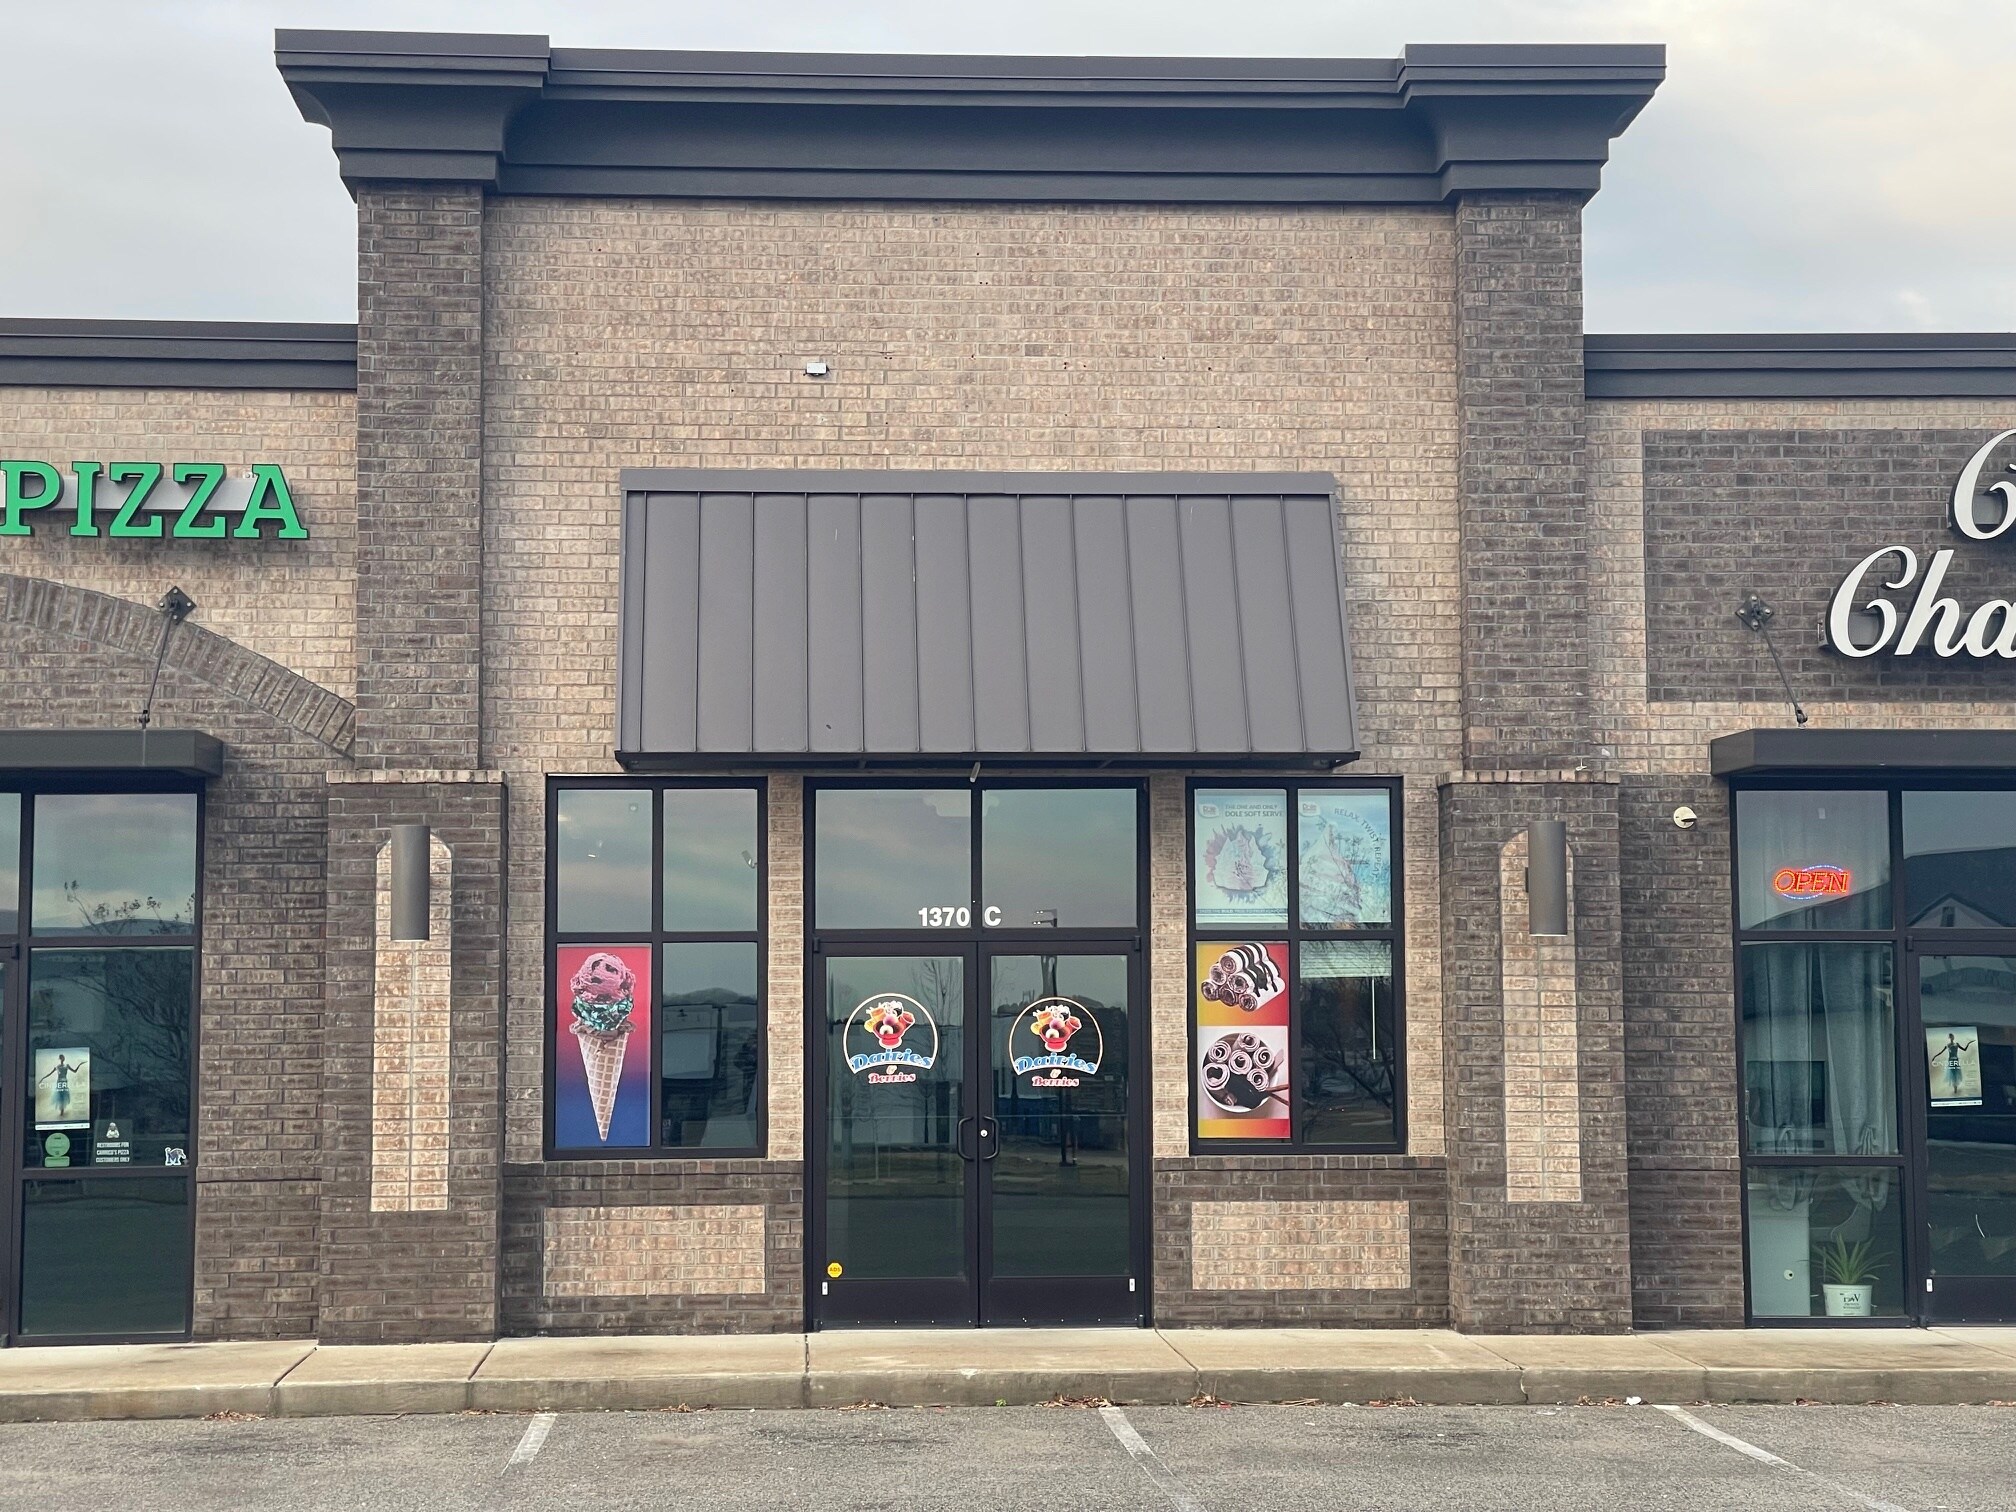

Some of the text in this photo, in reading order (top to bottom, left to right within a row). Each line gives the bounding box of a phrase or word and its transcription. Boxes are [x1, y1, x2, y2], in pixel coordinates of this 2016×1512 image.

[0, 460, 309, 540] PIZZA
[1773, 869, 1849, 893] OPEN
[918, 906, 1001, 926] 1370 C
[851, 1048, 932, 1070] Dairies
[1015, 1052, 1097, 1072] Dairies
[1032, 1076, 1080, 1086] Berries
